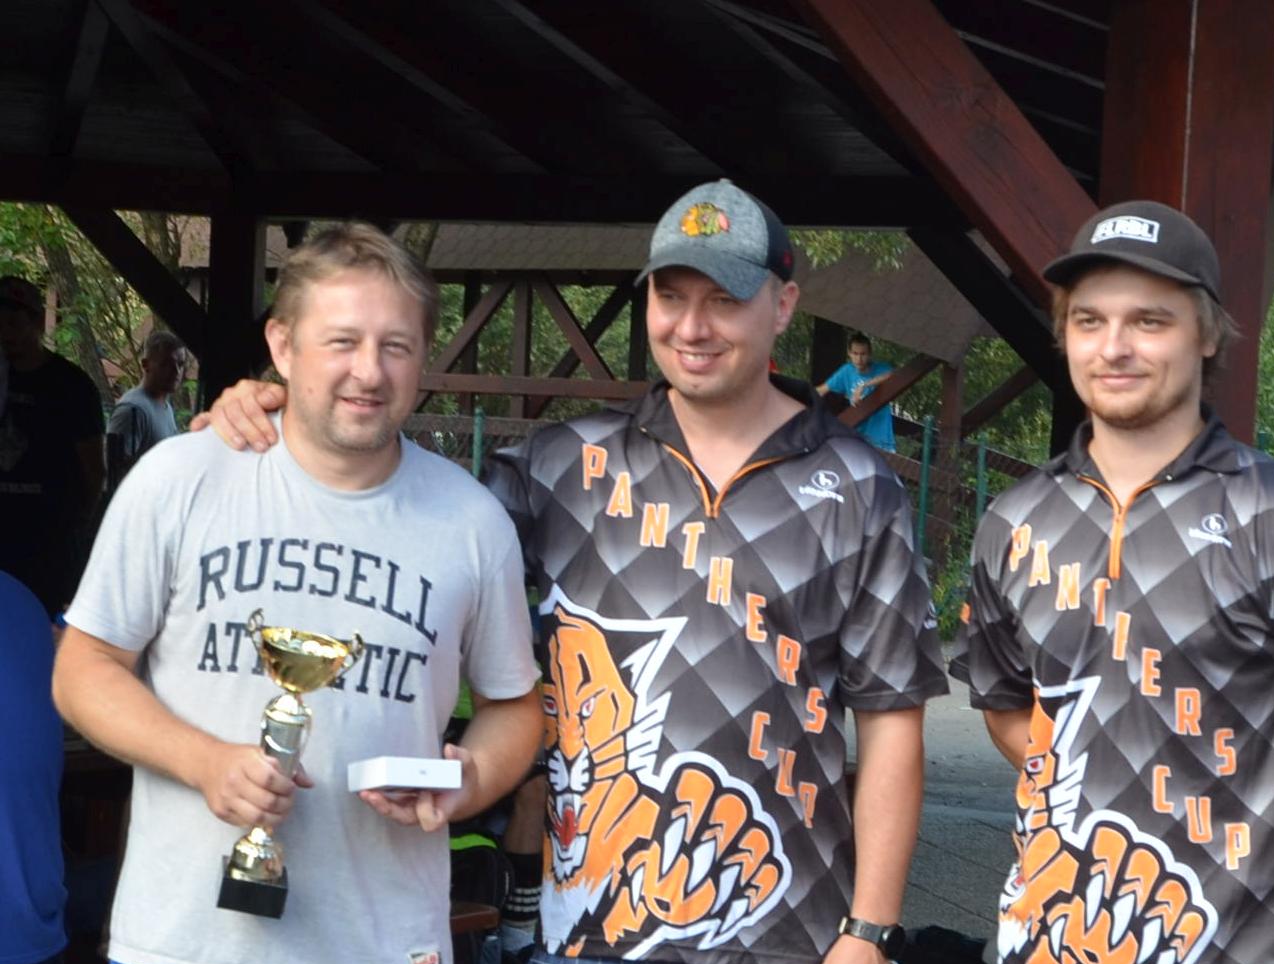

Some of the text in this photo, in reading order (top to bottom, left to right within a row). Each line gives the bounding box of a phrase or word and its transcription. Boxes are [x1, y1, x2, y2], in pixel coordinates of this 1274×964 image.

[196, 537, 438, 647] RUSSELL
[581, 443, 828, 735] PANTHERS
[197, 622, 428, 704] ATTIC
[1152, 765, 1251, 870] CUP
